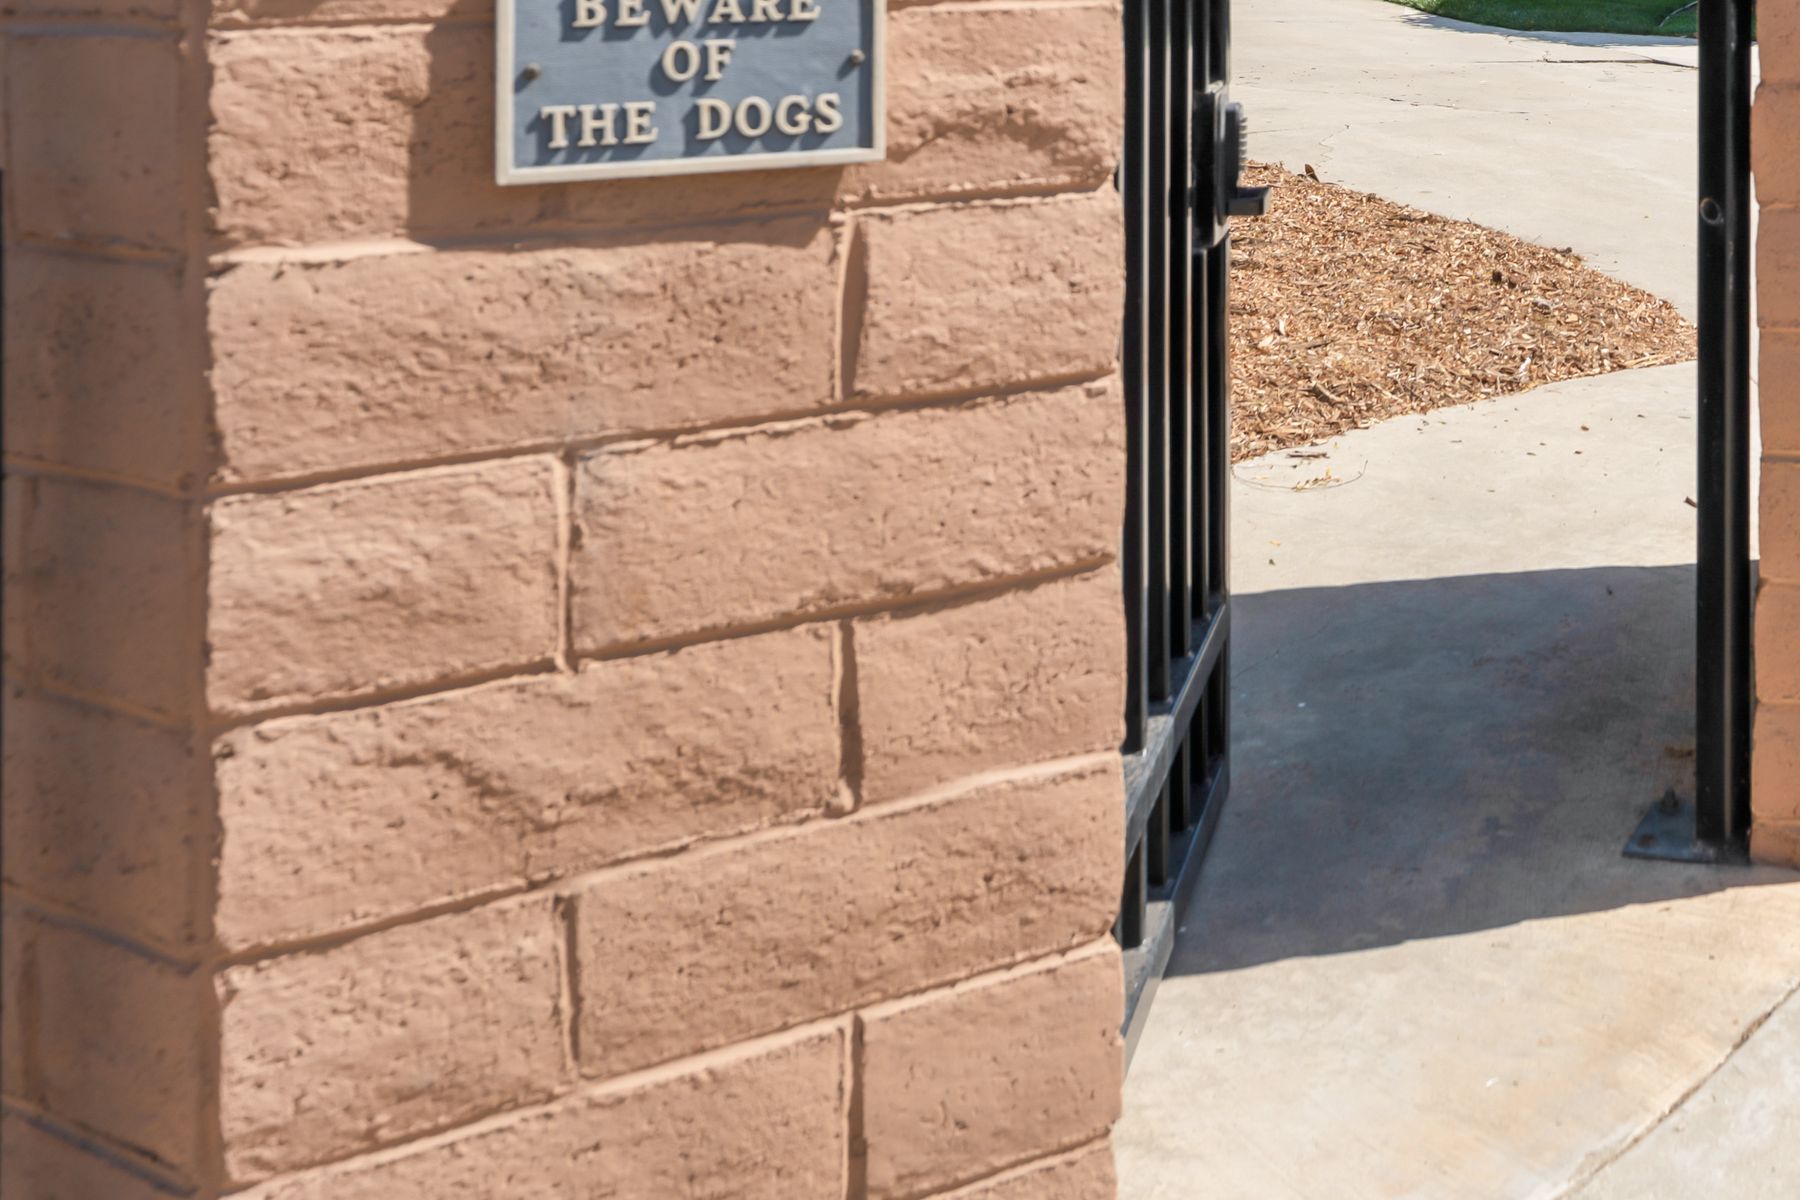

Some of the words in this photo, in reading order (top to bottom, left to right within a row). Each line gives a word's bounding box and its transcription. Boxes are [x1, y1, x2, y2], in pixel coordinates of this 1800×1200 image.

[661, 39, 737, 83] OF
[540, 101, 659, 149] THE
[695, 92, 844, 141] DOGS
